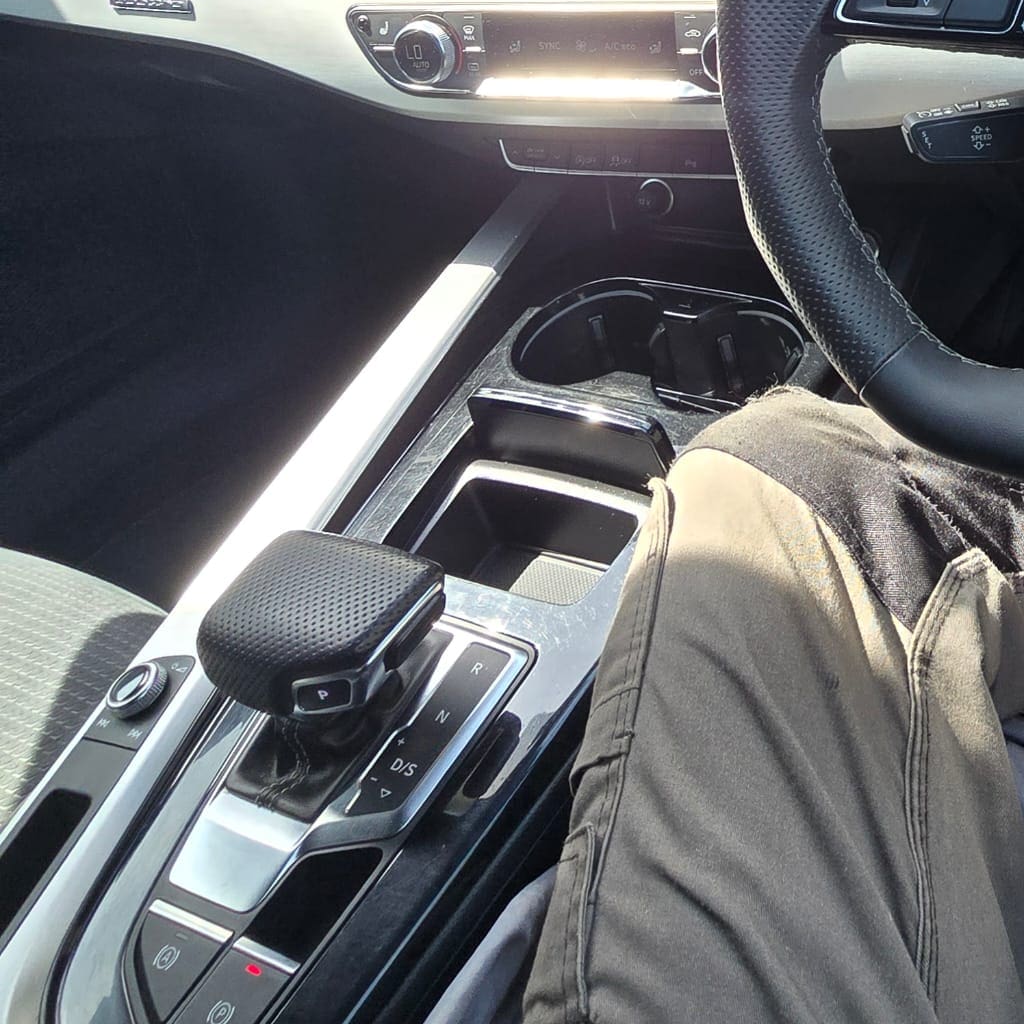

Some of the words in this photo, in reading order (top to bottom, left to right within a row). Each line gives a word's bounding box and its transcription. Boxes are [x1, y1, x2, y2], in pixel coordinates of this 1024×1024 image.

[538, 41, 560, 51] SYNC
[605, 41, 619, 51] A/C
[921, 130, 932, 149] SET
[971, 133, 992, 141] SPEED
[471, 662, 483, 675] R
[317, 690, 328, 700] P
[435, 709, 450, 724] N
[390, 758, 418, 777] D/S
